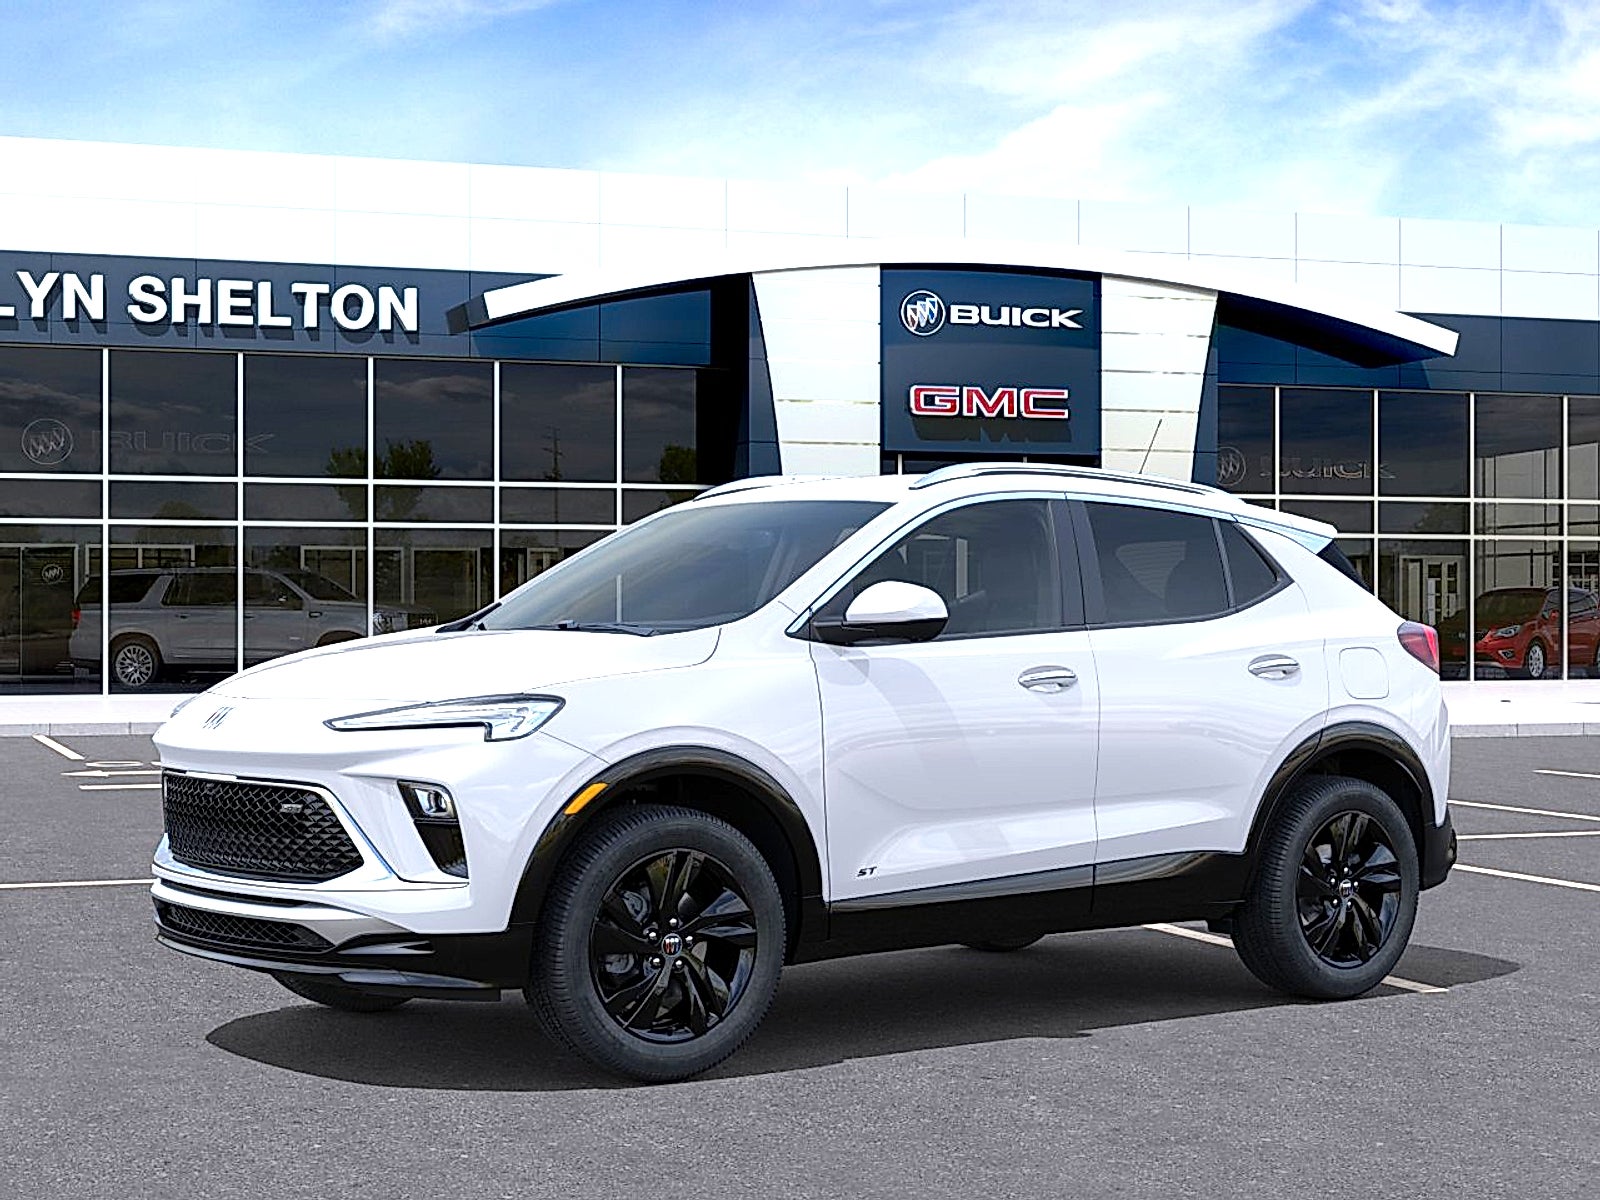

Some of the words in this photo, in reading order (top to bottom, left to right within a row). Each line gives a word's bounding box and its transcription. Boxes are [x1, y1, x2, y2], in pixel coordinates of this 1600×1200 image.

[127, 275, 418, 332] SHELTON
[950, 304, 1084, 329] BUICK
[909, 384, 1069, 419] GMC
[857, 866, 877, 877] ST
